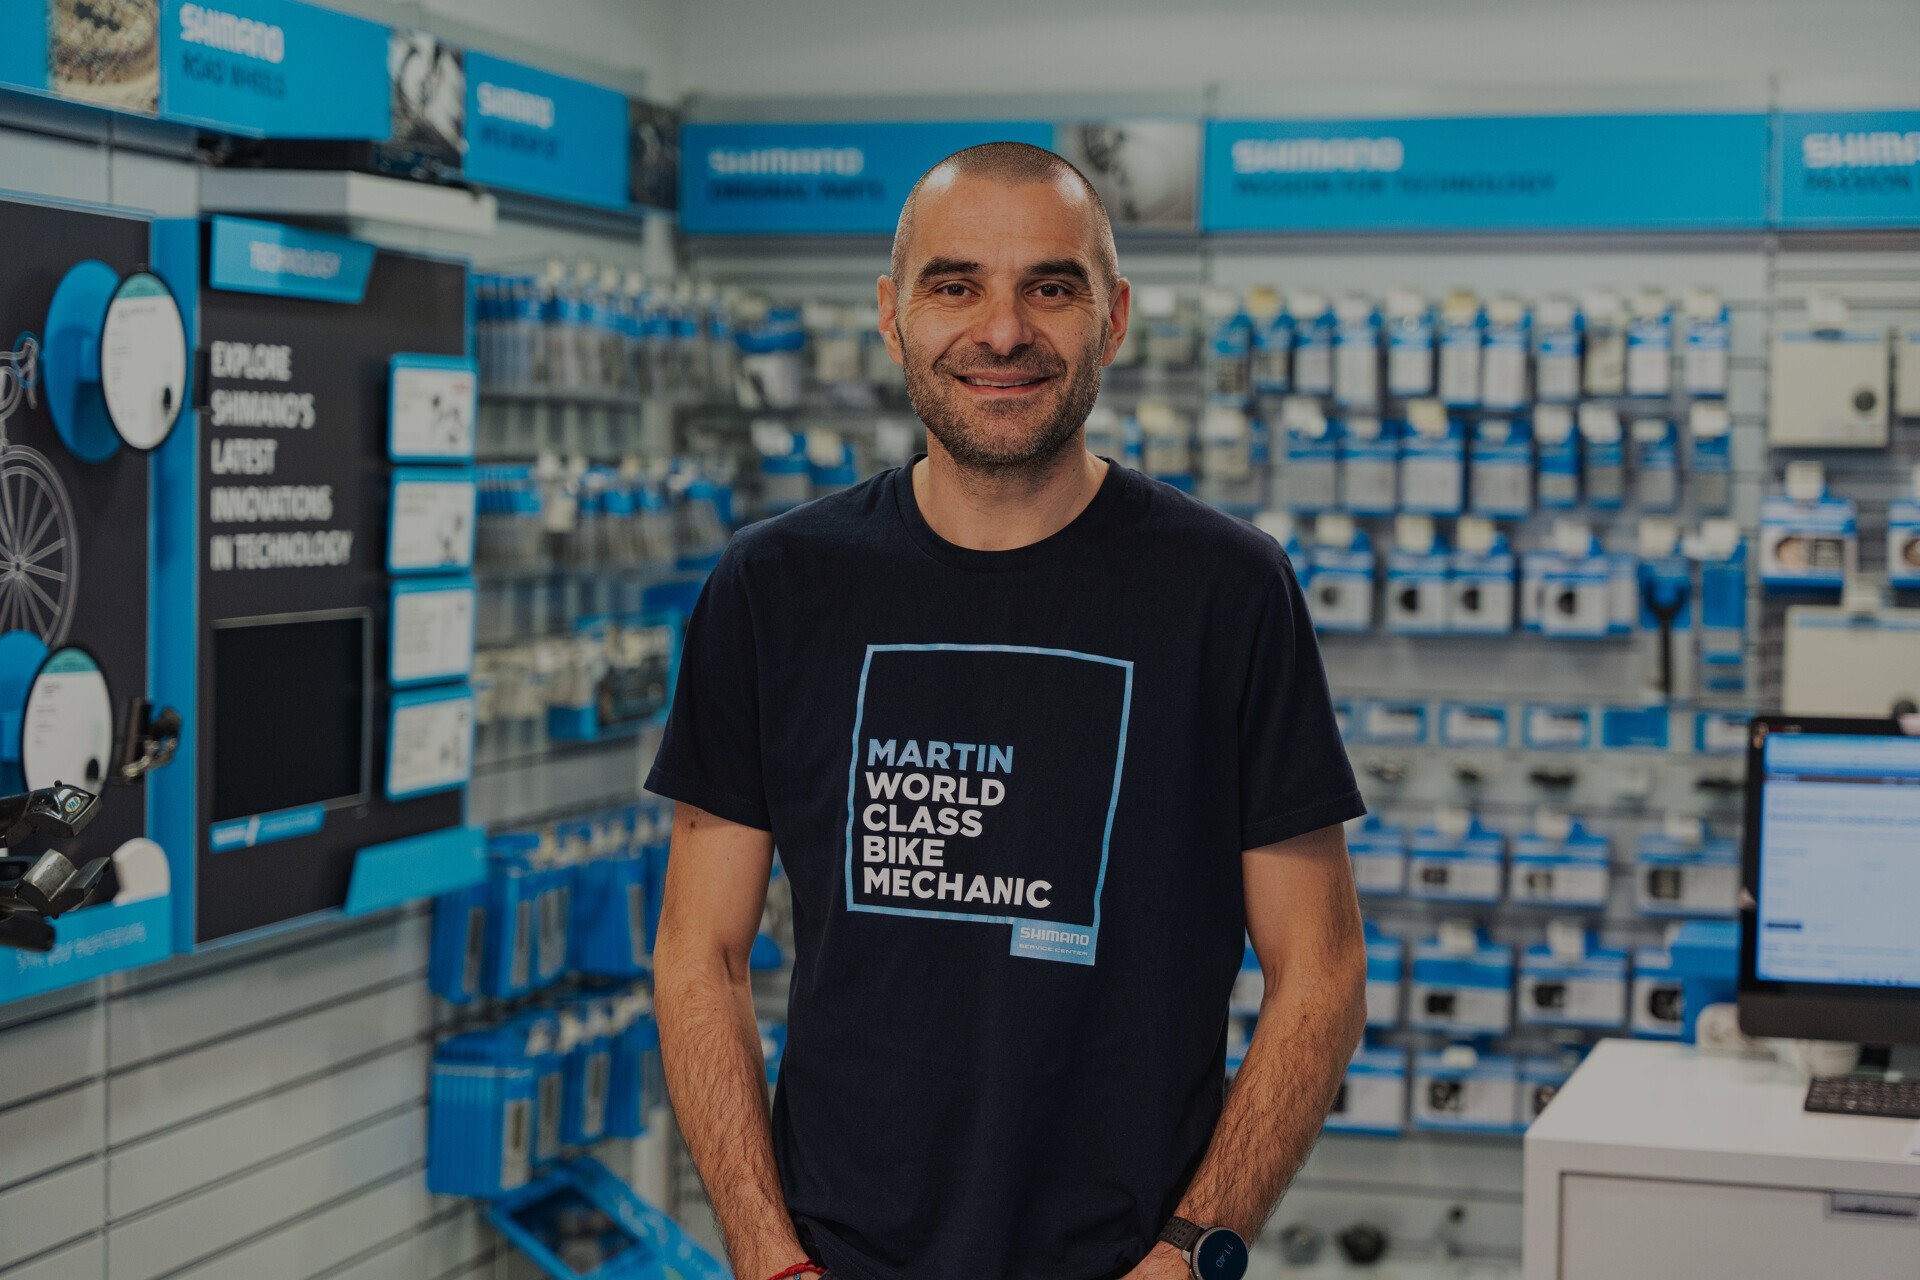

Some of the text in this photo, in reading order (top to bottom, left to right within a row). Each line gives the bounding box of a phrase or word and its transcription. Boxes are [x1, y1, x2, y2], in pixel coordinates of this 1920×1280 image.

[180, 3, 284, 64] SHIMANO
[708, 147, 864, 175] SHIMANO
[1232, 138, 1403, 172] SHIMANO
[211, 340, 292, 381] EXPLORE
[211, 389, 315, 429] SHIMANO'S
[211, 437, 278, 475] LATEST
[210, 485, 333, 522] INNOVATIONS
[210, 530, 353, 570] IN TECHNOLOGY
[867, 738, 1014, 774] MARTIN
[865, 772, 1006, 806] WORLD
[862, 804, 983, 837] CLASS
[863, 835, 945, 867] BIKE
[863, 867, 1053, 909] MECHANIC
[1019, 943, 1088, 956] SERVICE CENTER
[1020, 927, 1090, 946] SHIMANO
[1215, 1244, 1234, 1268] 11:40
